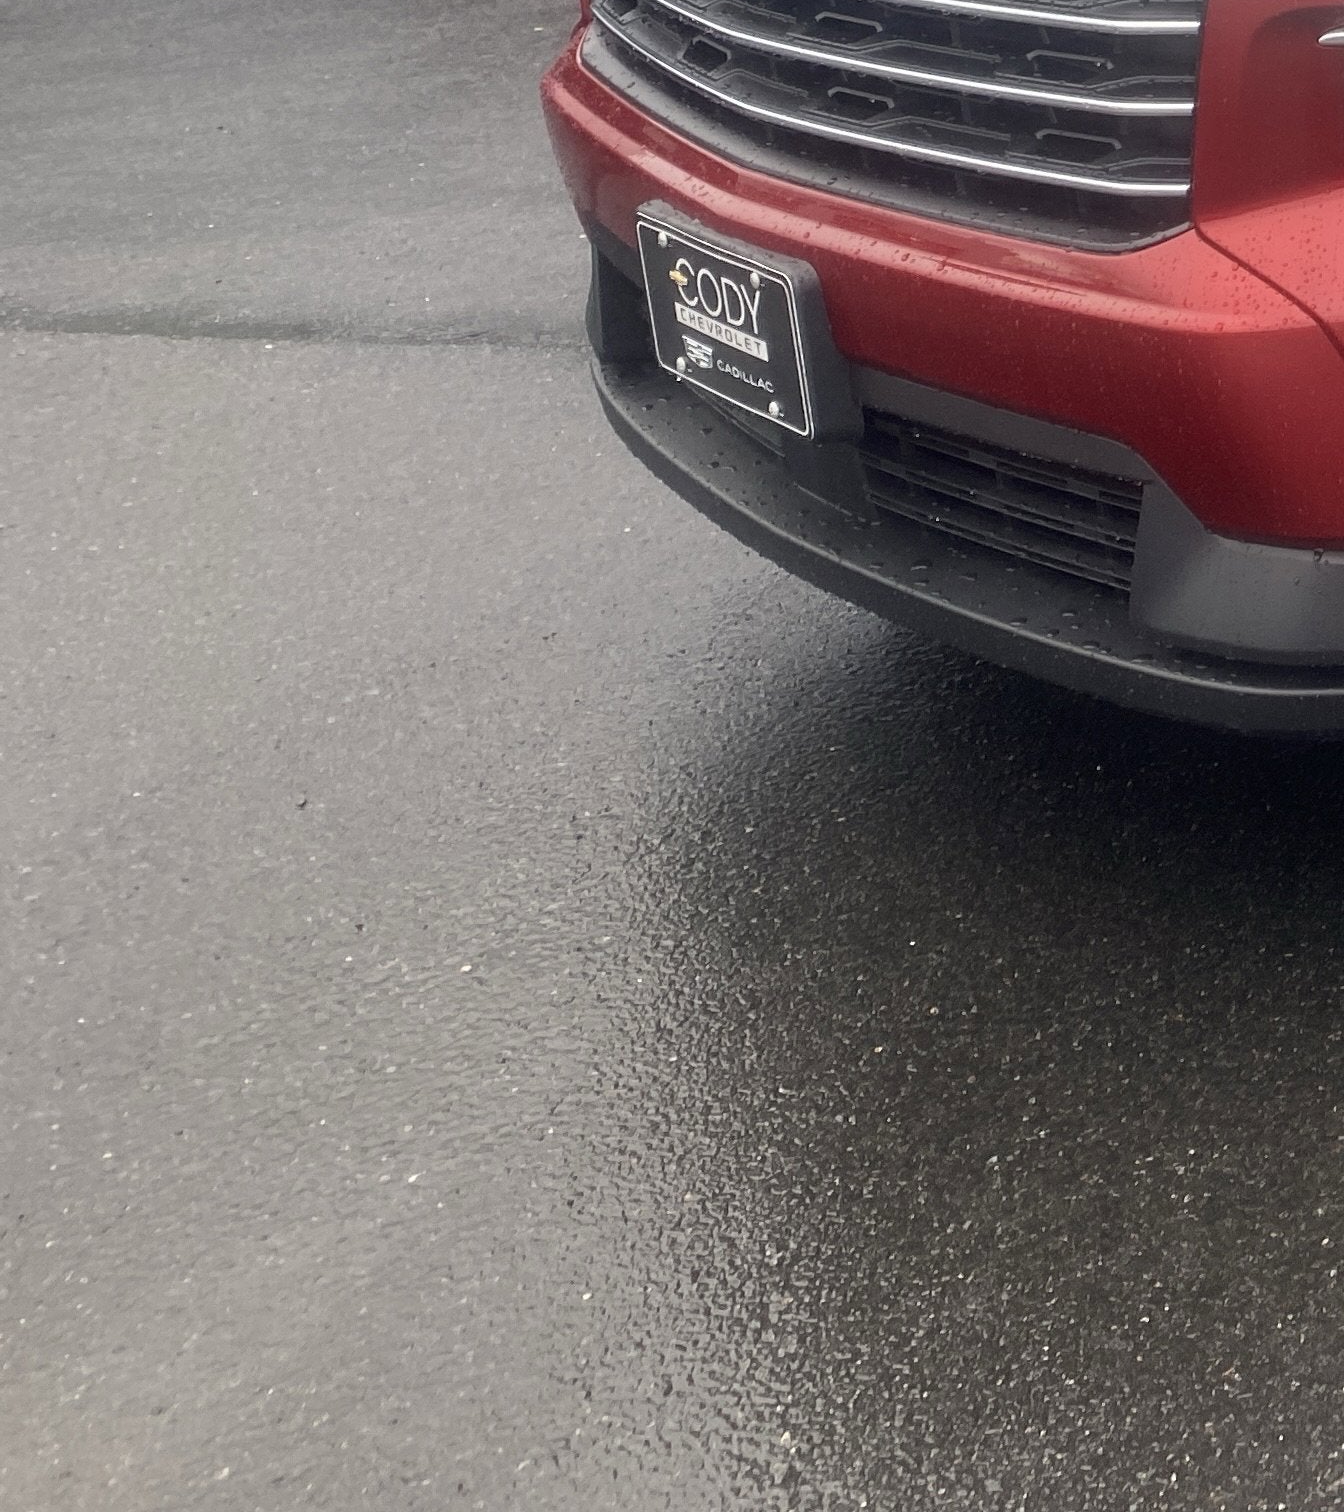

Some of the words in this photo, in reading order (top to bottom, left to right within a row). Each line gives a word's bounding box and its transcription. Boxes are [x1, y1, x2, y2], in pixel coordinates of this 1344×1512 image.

[675, 258, 761, 334] CODY
[679, 307, 763, 354] CHEVROLET
[716, 359, 775, 393] CADILLAC
